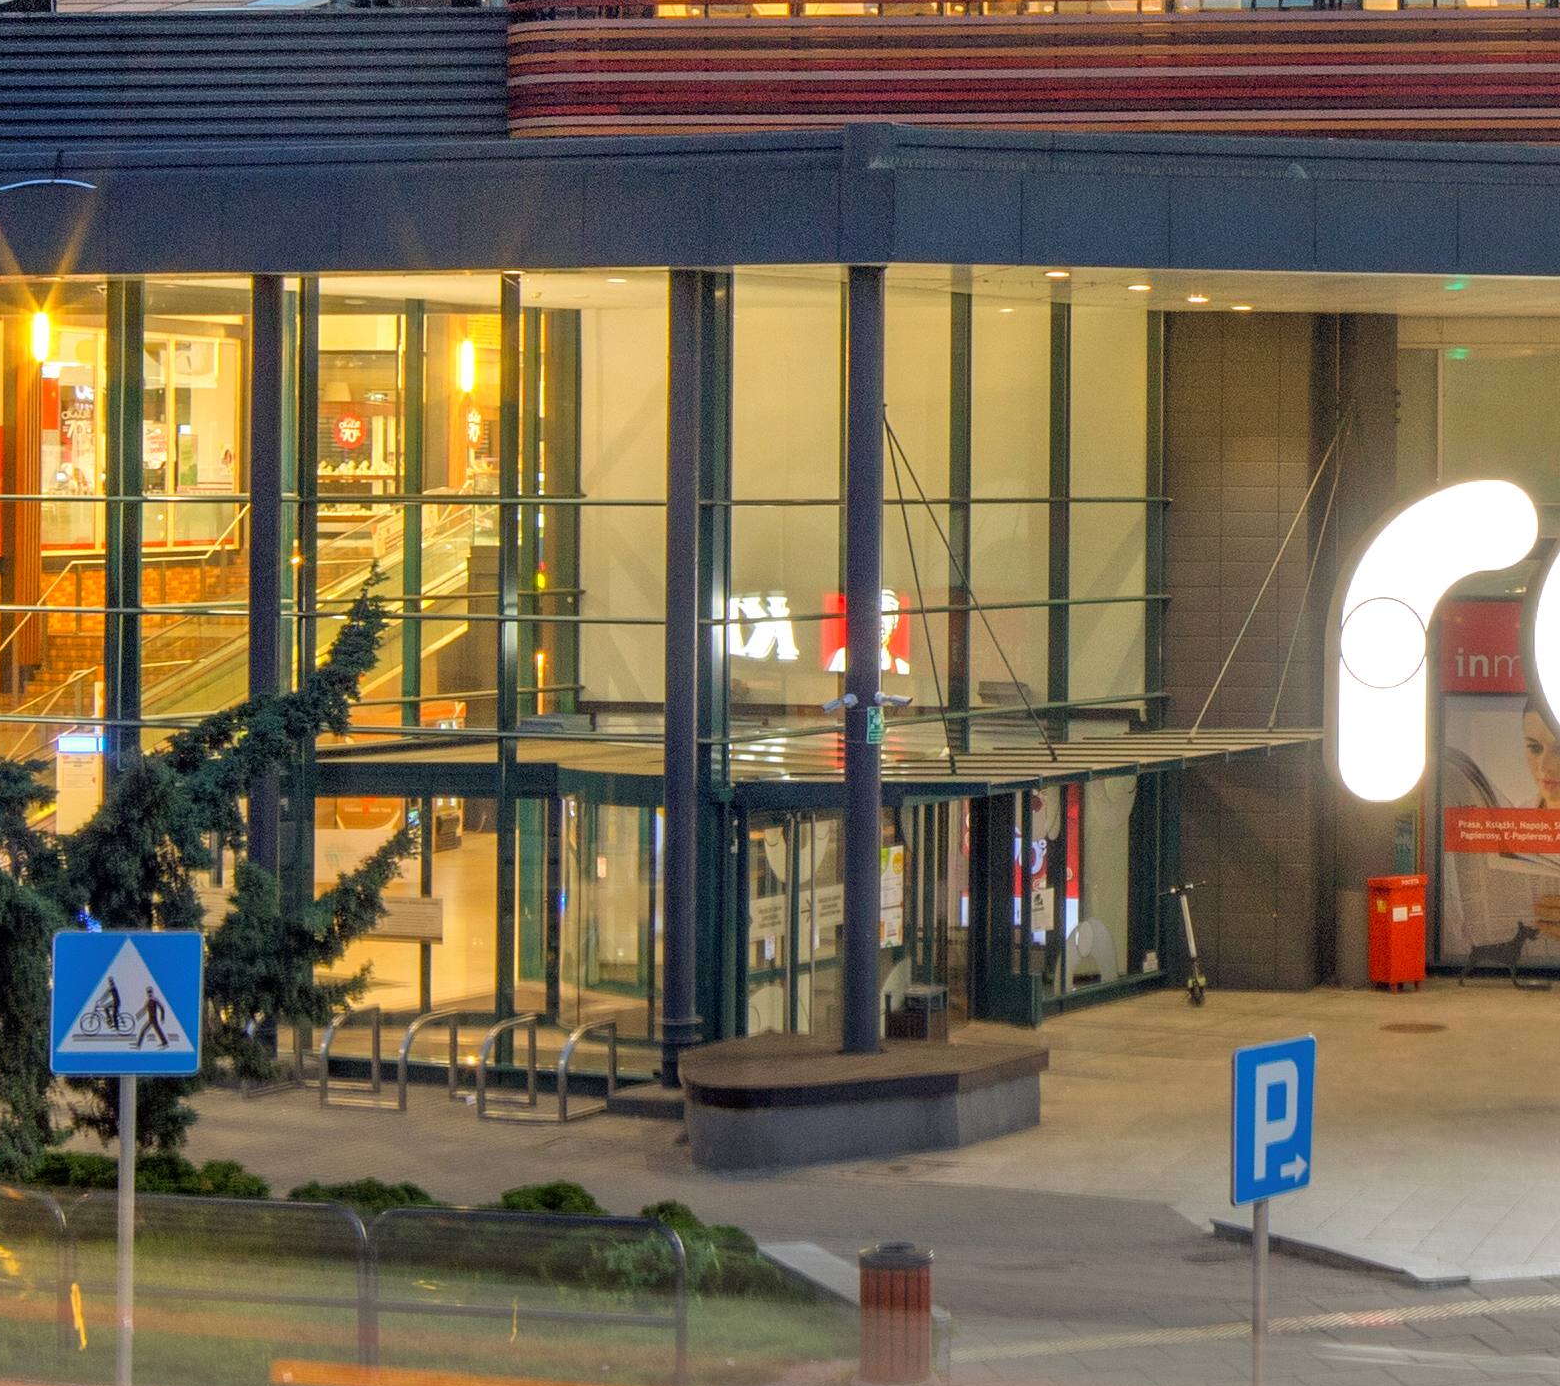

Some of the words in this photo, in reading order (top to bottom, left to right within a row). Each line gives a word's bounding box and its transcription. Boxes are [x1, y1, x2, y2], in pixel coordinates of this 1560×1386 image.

[1458, 820, 1483, 831] Prasa,
[1519, 821, 1551, 832] Napoje,
[1460, 831, 1502, 842] Papierosy,
[1253, 1059, 1299, 1181] P
